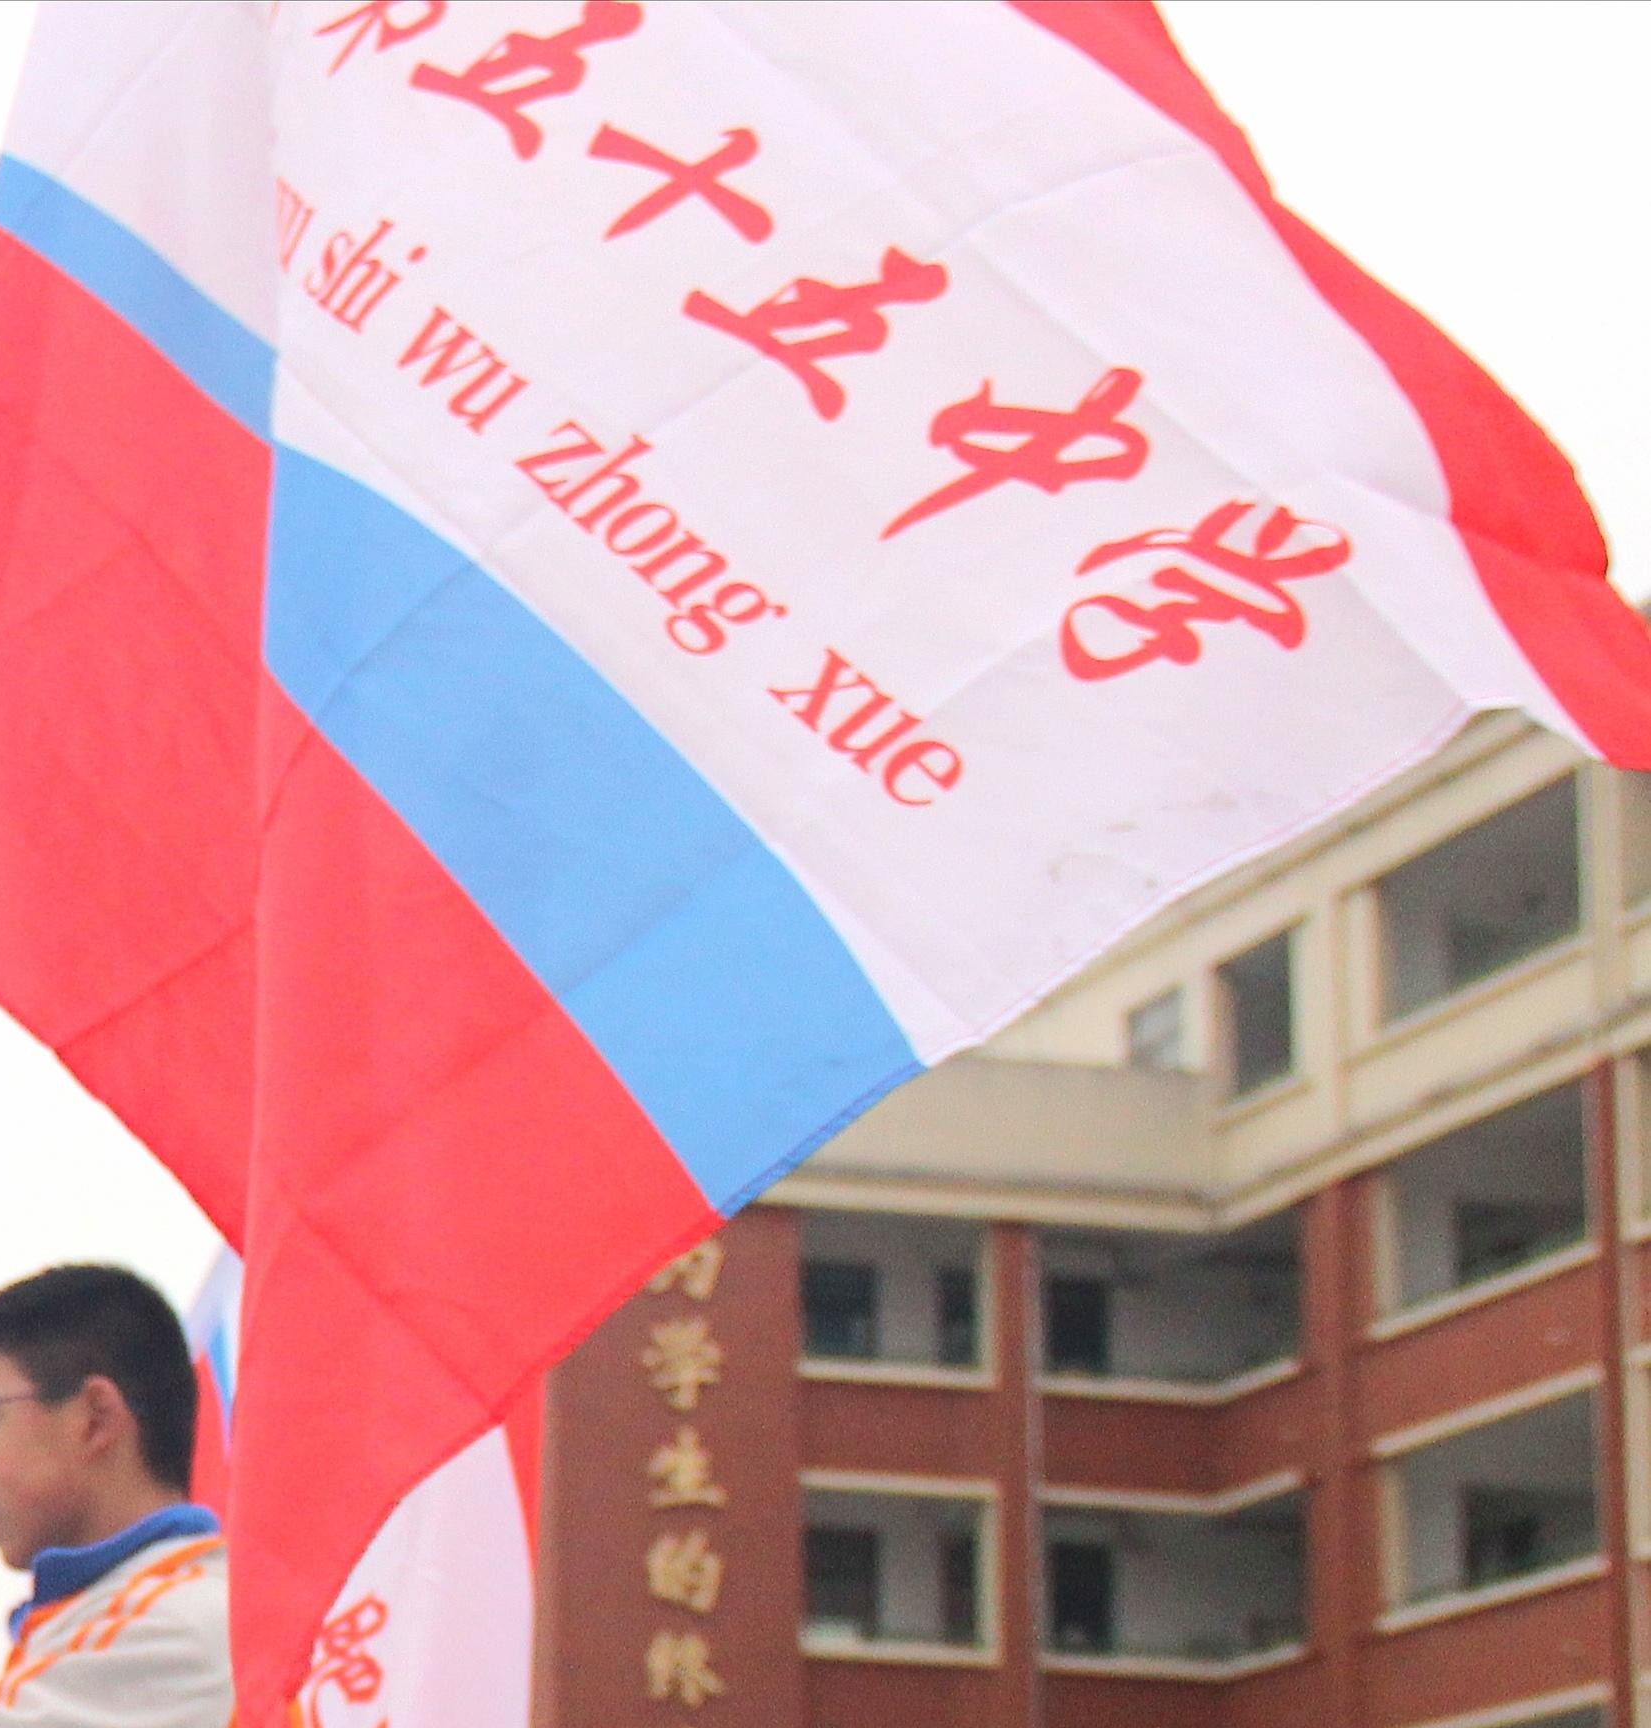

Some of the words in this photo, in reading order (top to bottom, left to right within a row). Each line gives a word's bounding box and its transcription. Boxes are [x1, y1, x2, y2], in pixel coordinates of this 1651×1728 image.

[303, 218, 428, 335] shi
[396, 304, 529, 436] wu
[518, 419, 789, 659] zhong
[767, 647, 964, 809] xue
